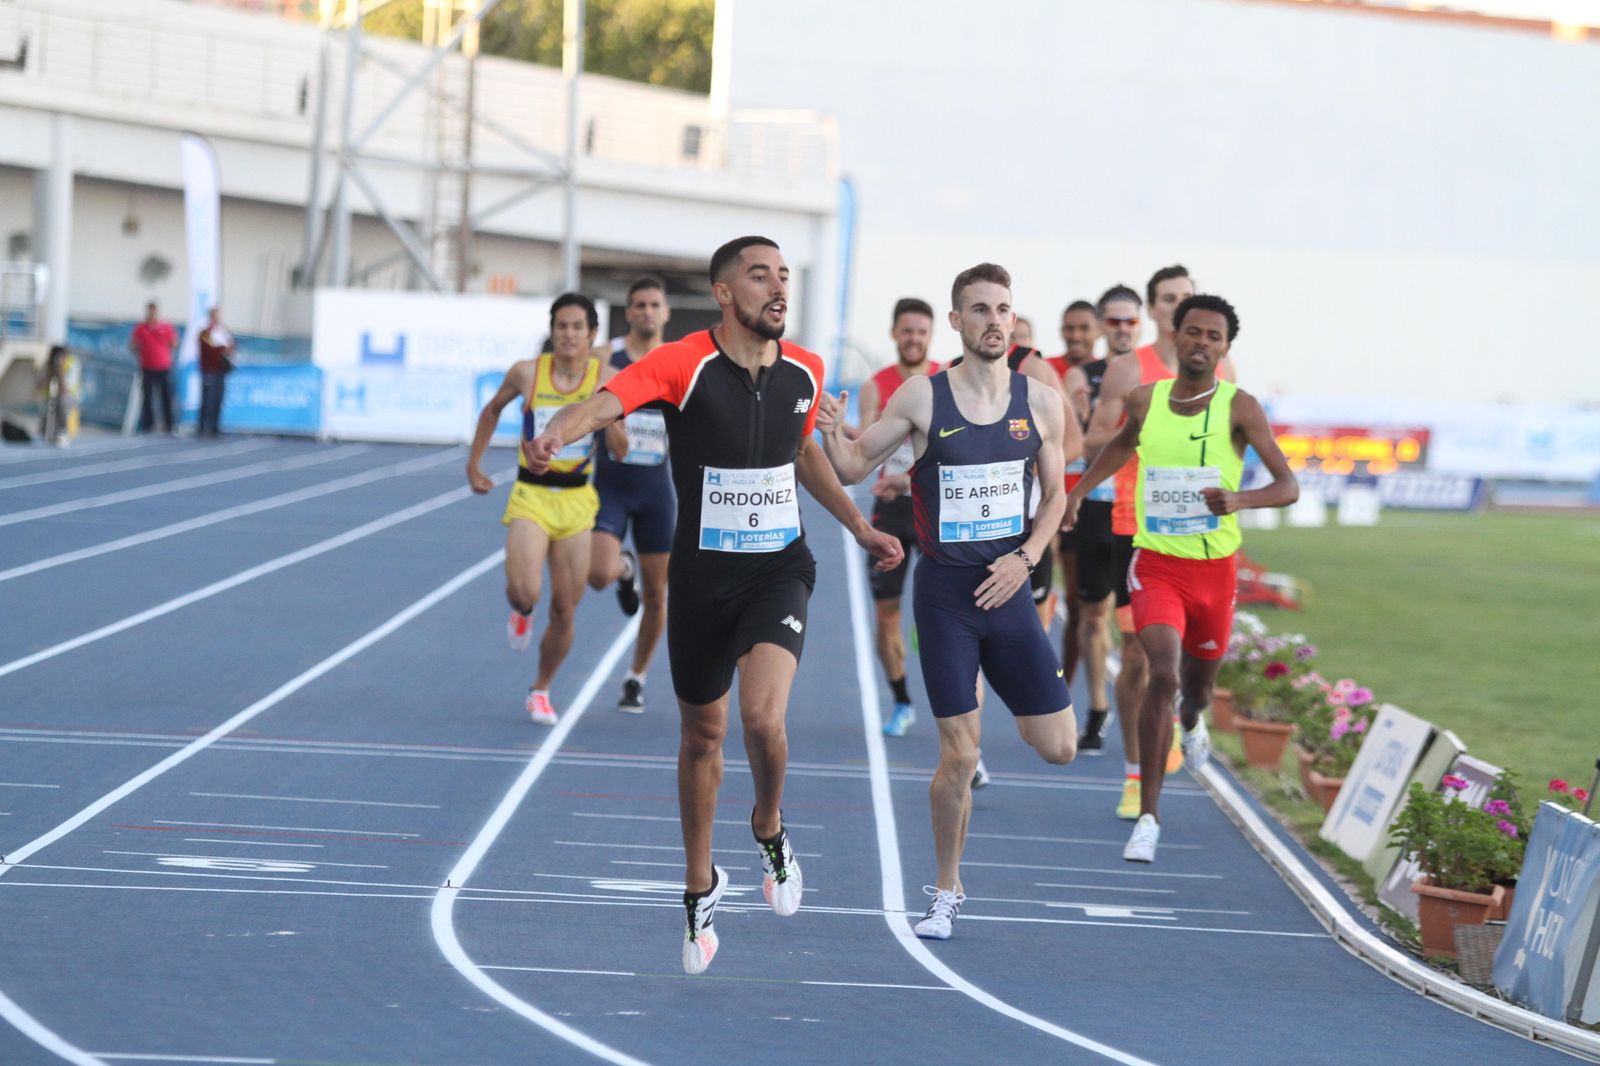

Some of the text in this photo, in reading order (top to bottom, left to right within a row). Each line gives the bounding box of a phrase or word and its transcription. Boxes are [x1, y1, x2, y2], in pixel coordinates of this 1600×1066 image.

[709, 488, 792, 506] ORDOÑEZ
[945, 482, 1020, 500] DE ARRIBA
[1152, 490, 1205, 504] BODEN
[981, 504, 990, 518] 8
[749, 513, 759, 528] 6
[975, 519, 1013, 531] LOTERÍAS
[741, 532, 784, 542] LOTERÍAS
